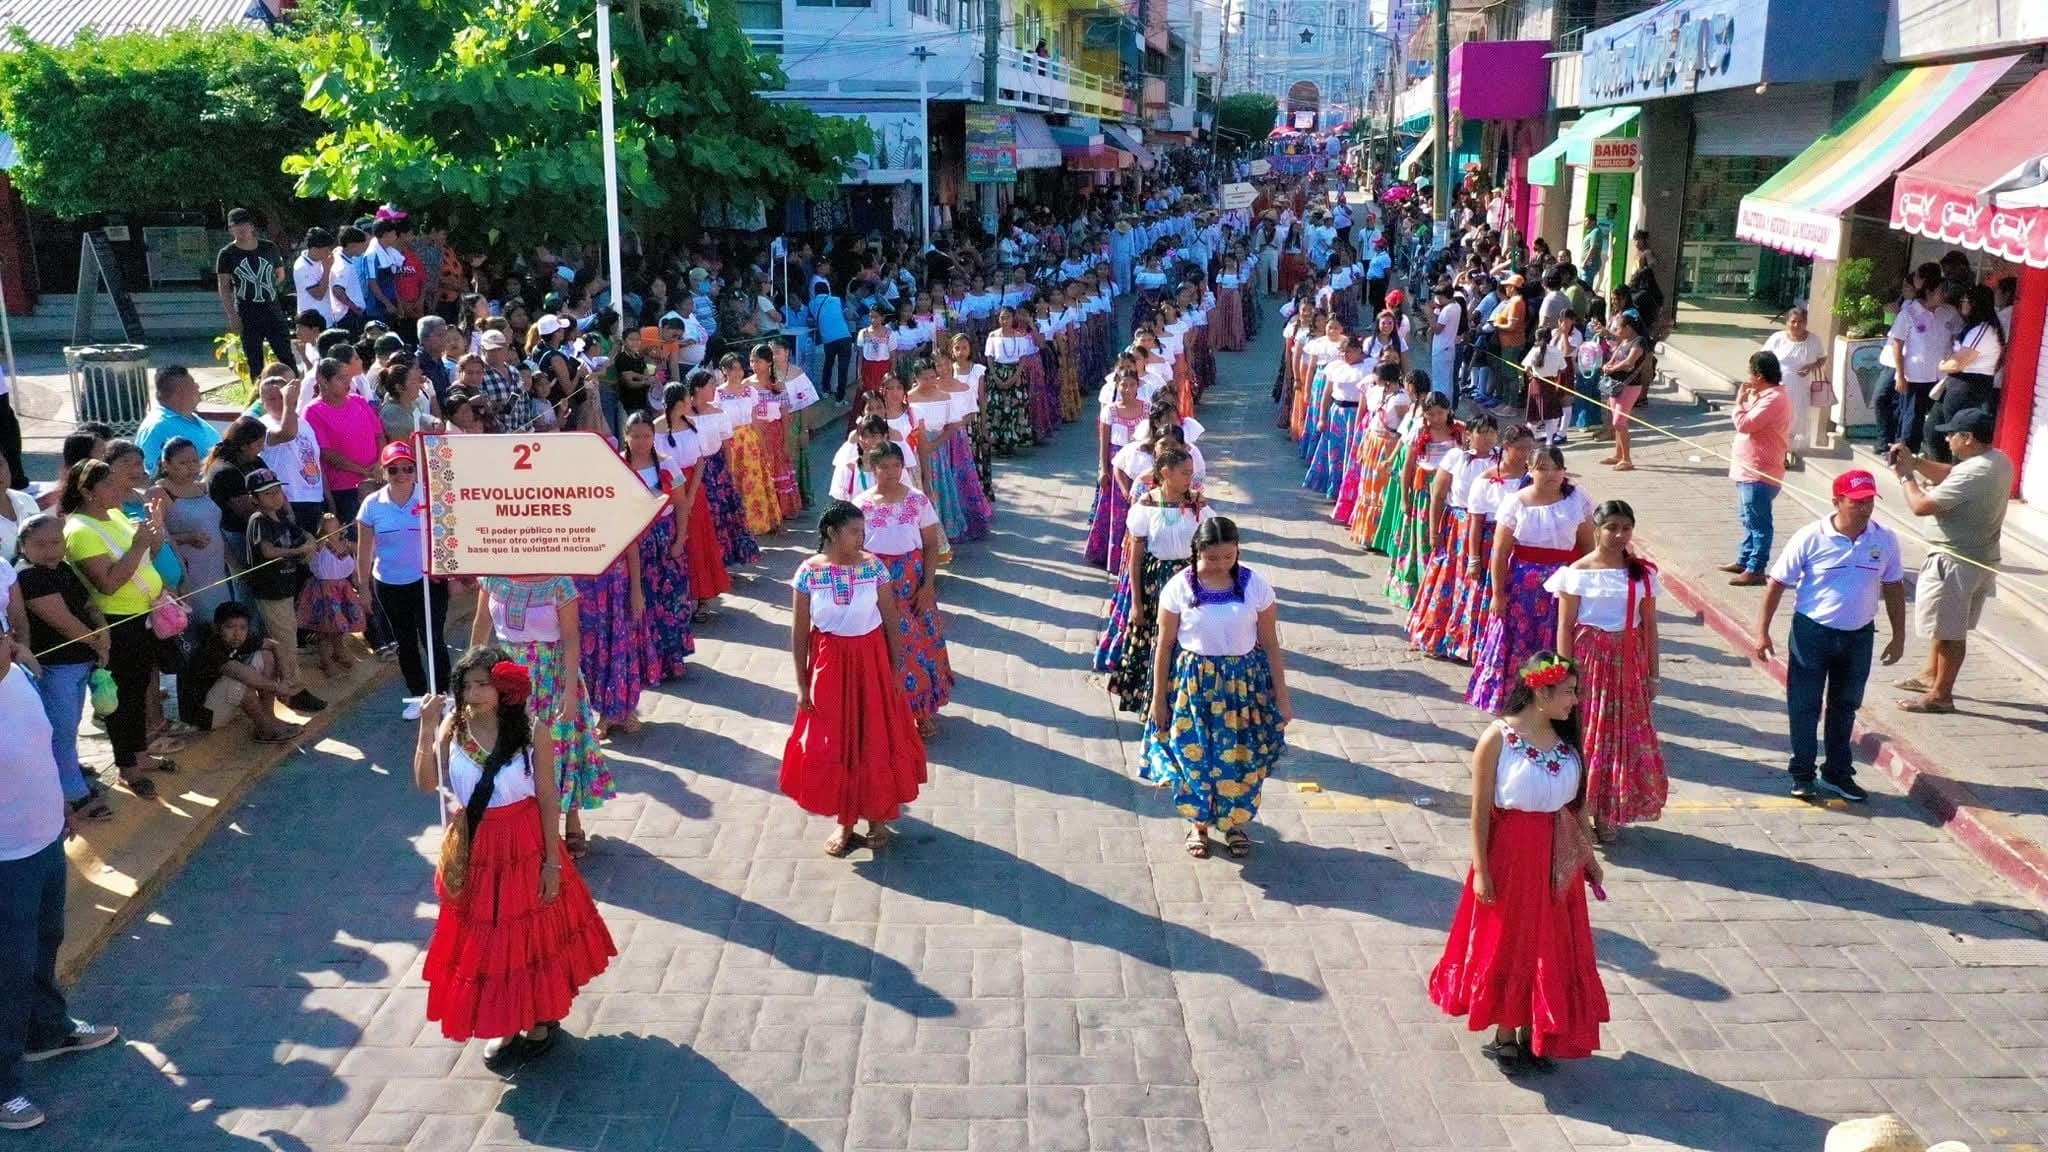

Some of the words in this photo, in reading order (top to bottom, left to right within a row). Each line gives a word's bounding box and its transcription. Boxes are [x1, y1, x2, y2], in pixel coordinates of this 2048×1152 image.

[460, 486, 615, 500] REVOLUCIONARIOS
[496, 503, 572, 516] MUJERES
[491, 527, 517, 537] poder
[569, 526, 596, 536] puede
[482, 537, 507, 545] tener
[509, 537, 528, 545] otro
[530, 535, 559, 545] origen
[561, 535, 570, 543] ni
[572, 535, 591, 543] otra
[467, 546, 489, 554] base
[491, 547, 509, 555] que
[522, 544, 561, 553] voluntad
